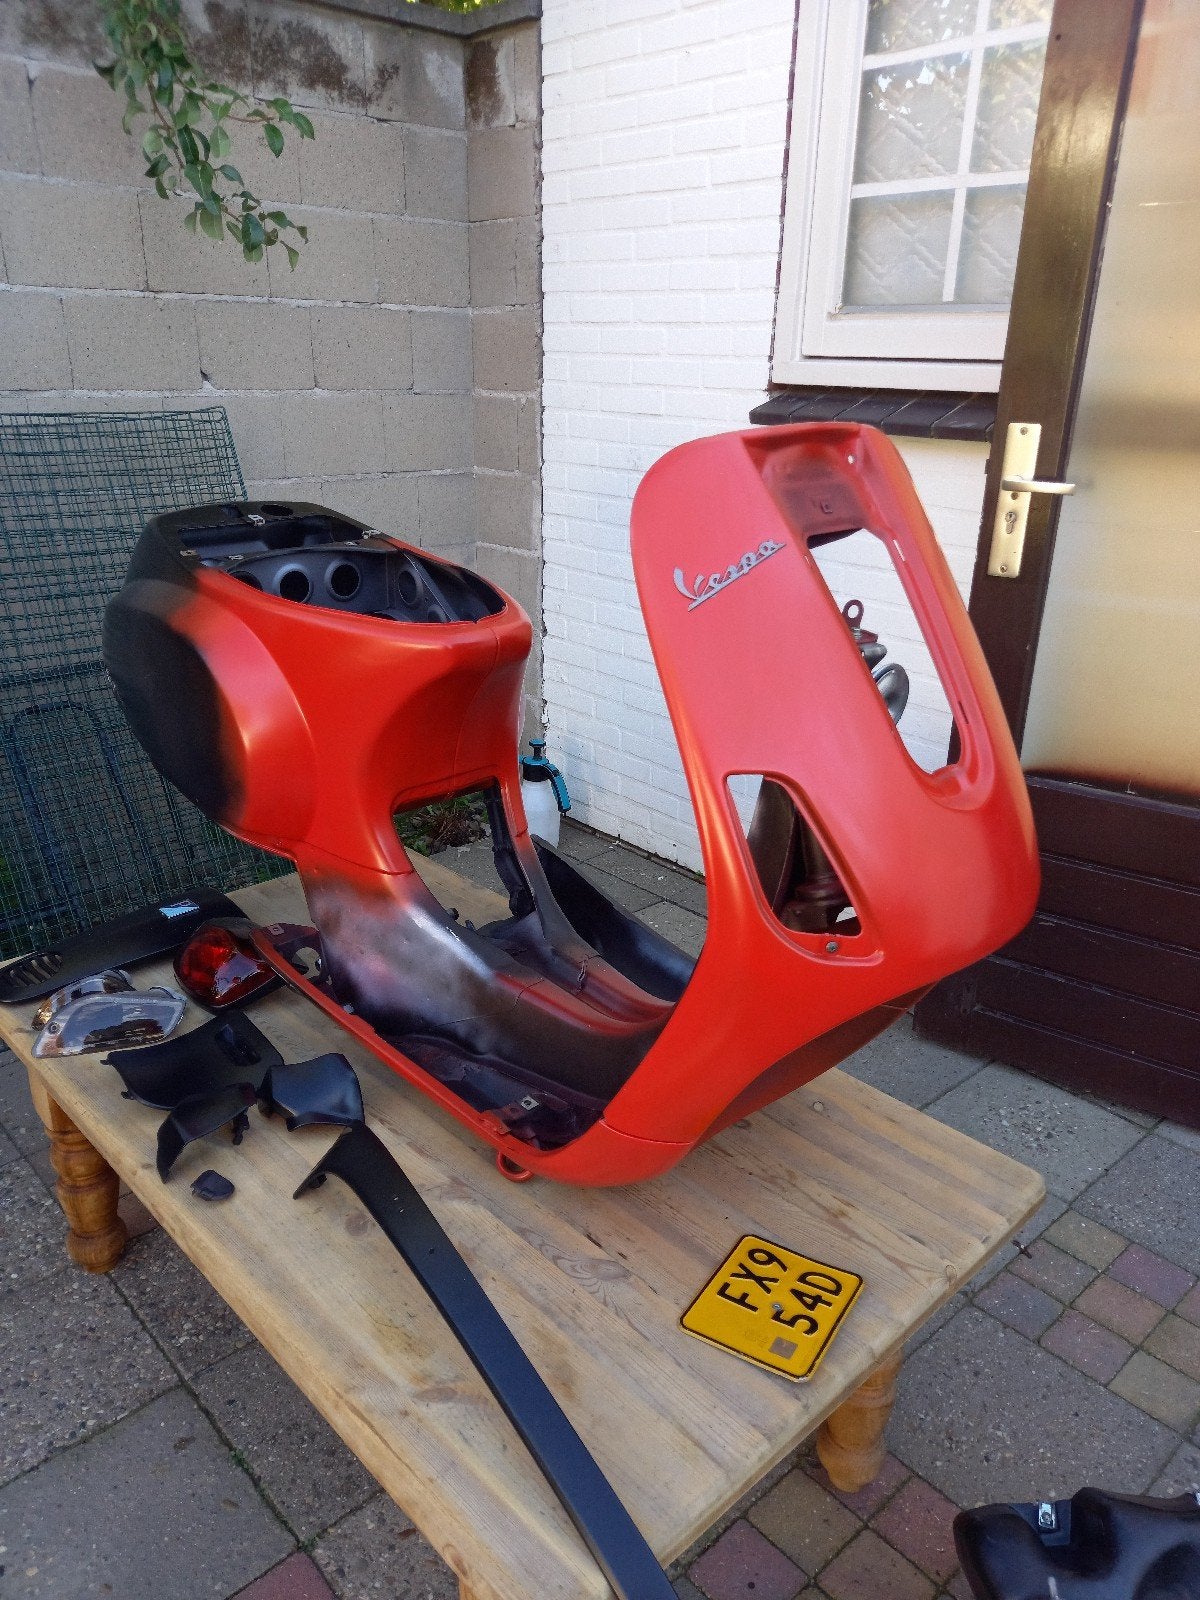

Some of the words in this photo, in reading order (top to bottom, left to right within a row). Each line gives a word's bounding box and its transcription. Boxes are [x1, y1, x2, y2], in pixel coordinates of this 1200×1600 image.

[673, 539, 787, 612] Vespa
[716, 1248, 788, 1313] FX9
[771, 1271, 843, 1336] 54D
